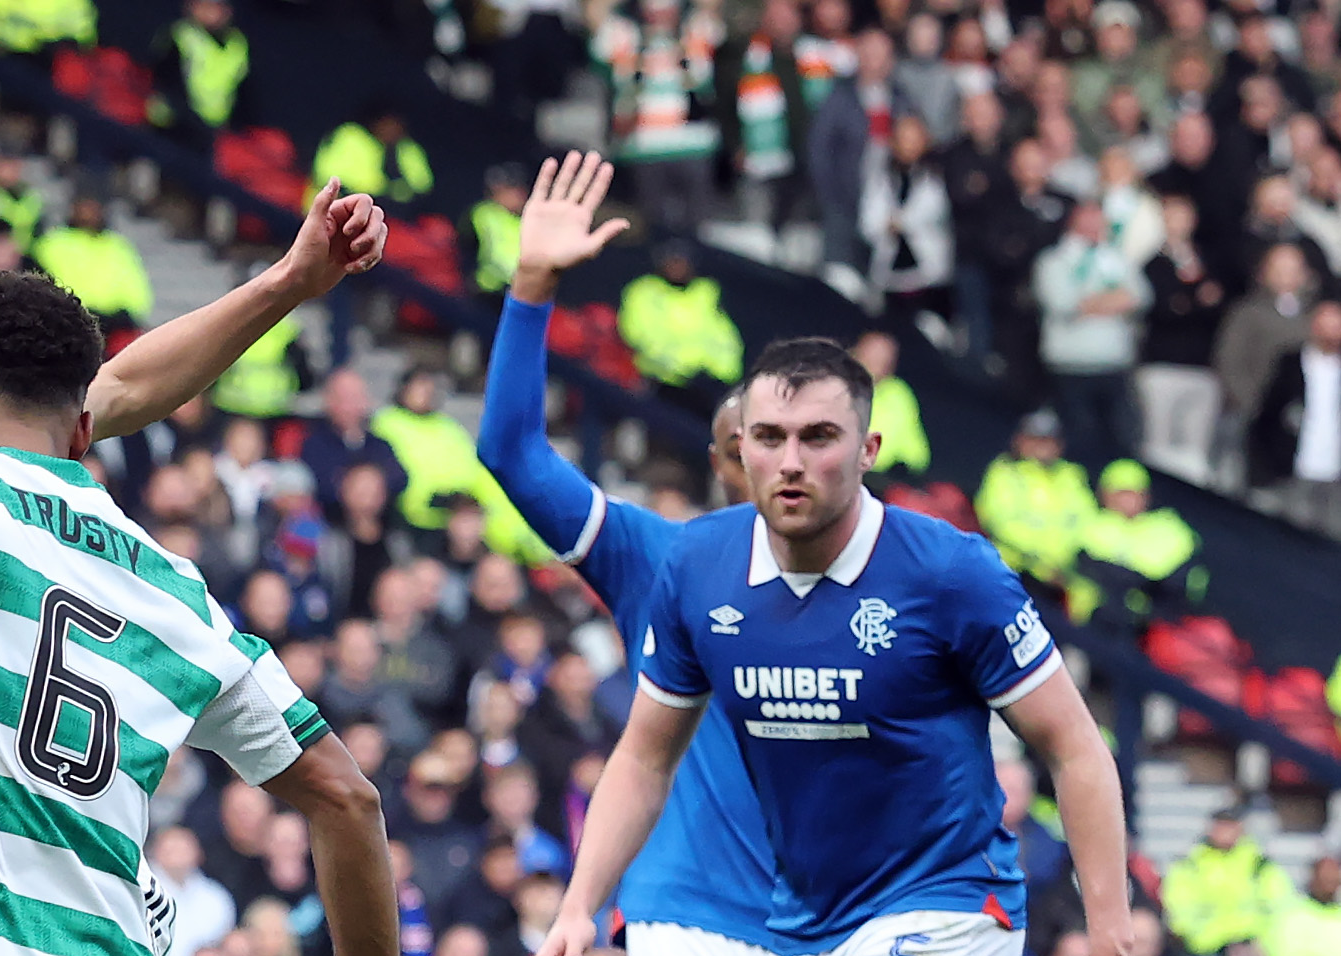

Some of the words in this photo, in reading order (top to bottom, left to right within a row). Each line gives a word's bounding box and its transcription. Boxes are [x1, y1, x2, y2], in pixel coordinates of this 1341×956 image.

[11, 486, 142, 574] TRUSTY
[14, 584, 128, 802] 6
[733, 665, 864, 702] UNIBET
